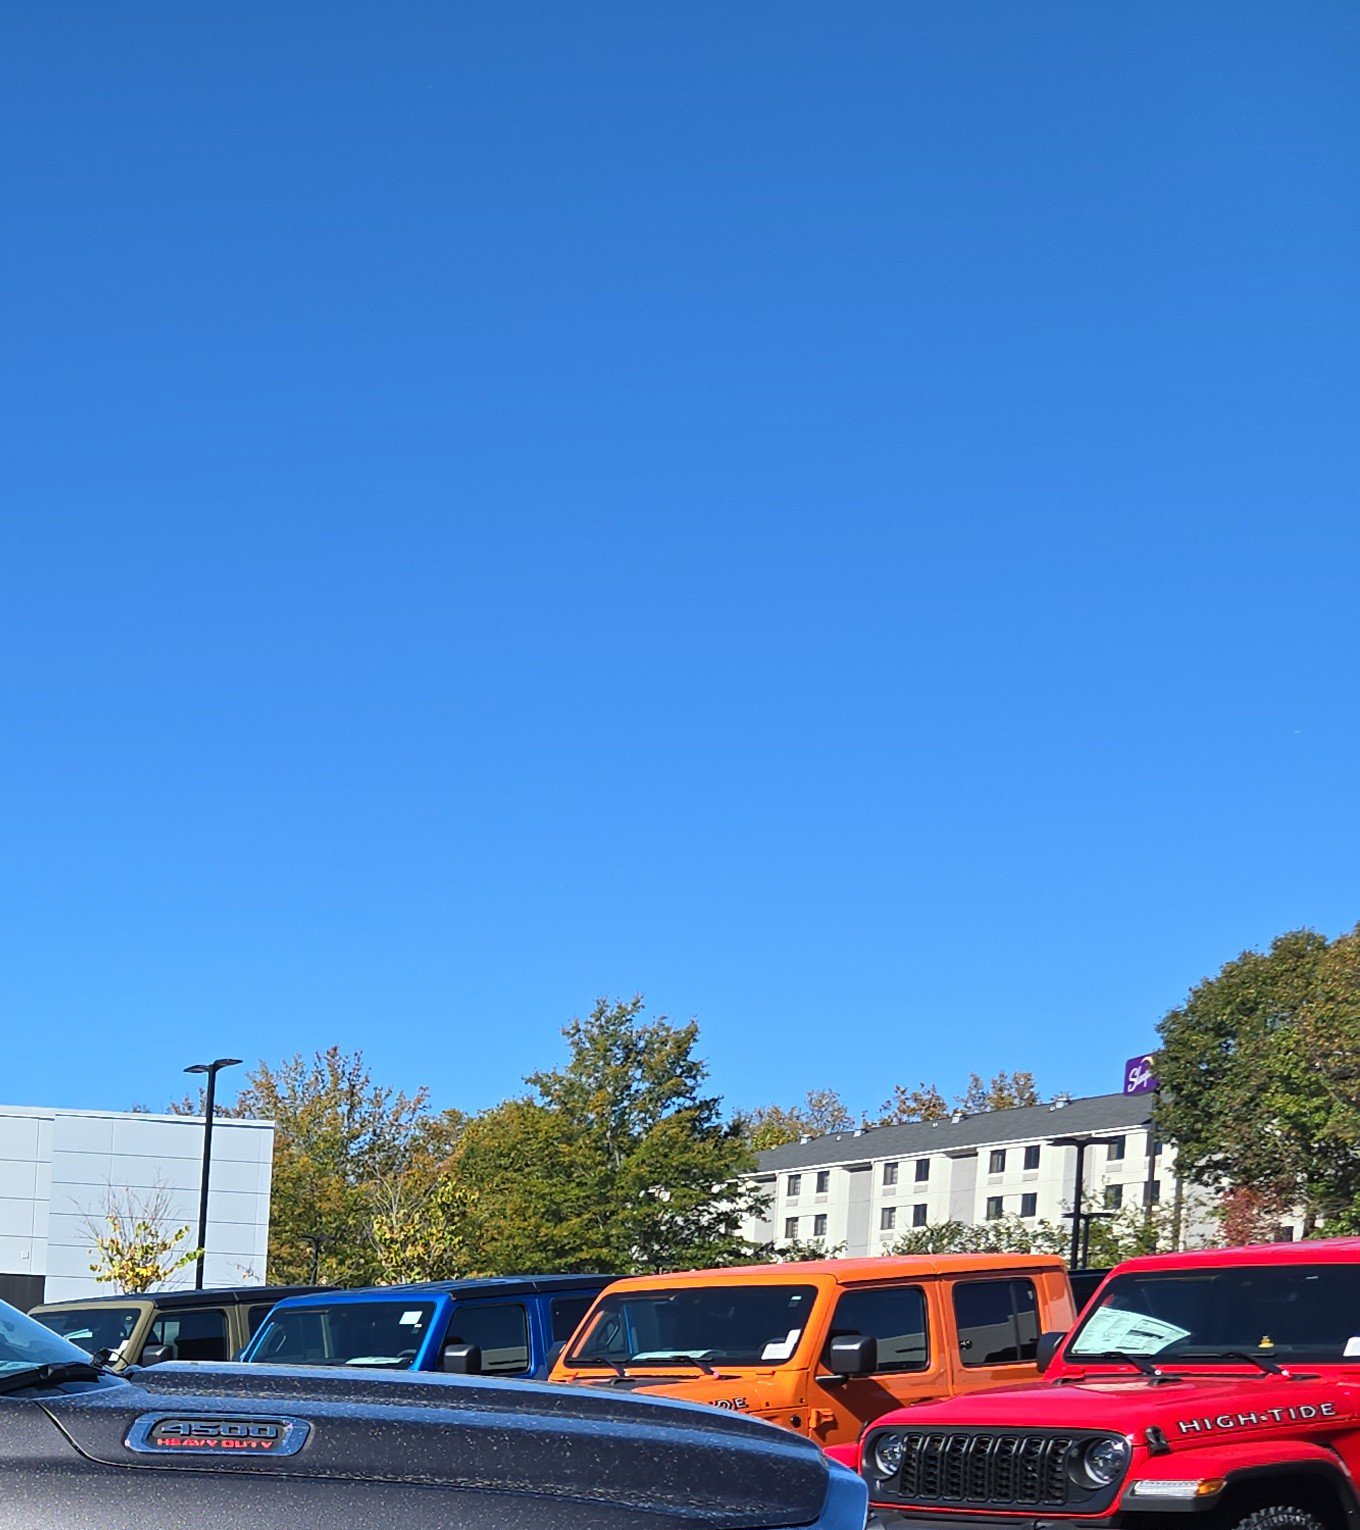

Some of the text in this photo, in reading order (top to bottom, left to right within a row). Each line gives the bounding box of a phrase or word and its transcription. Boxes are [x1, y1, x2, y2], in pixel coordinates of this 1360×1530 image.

[160, 1422, 279, 1438] 4500
[156, 1438, 273, 1450] HEAVY DUTY
